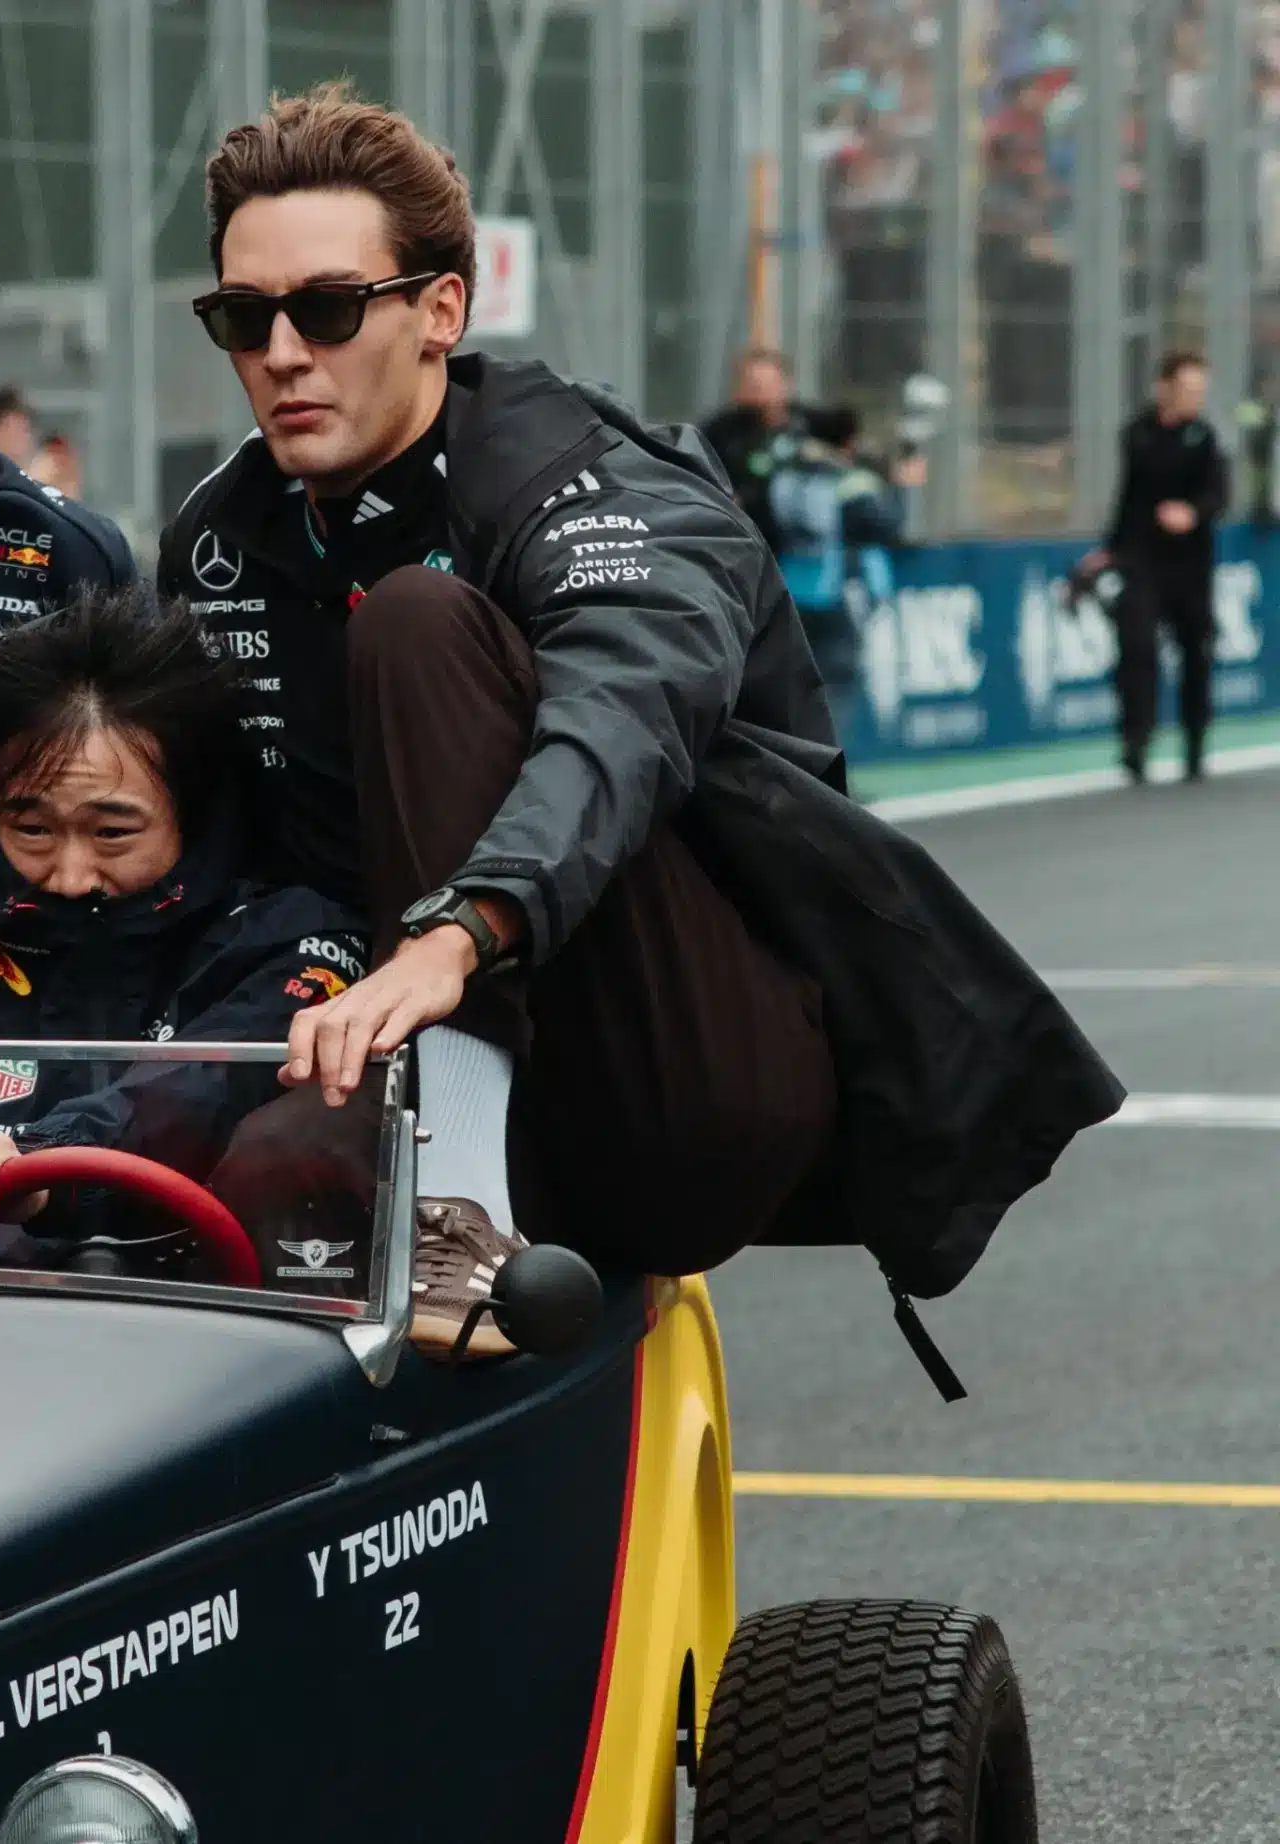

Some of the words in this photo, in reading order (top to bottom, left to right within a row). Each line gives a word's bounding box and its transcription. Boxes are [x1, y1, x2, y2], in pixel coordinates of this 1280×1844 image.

[562, 515, 650, 536] SOLERA
[207, 599, 266, 614] AMG
[308, 1545, 332, 1598] Y
[340, 1480, 488, 1584] TSUNODA
[384, 1590, 421, 1651] 22
[9, 1588, 240, 1729] VERSTAPPEN
